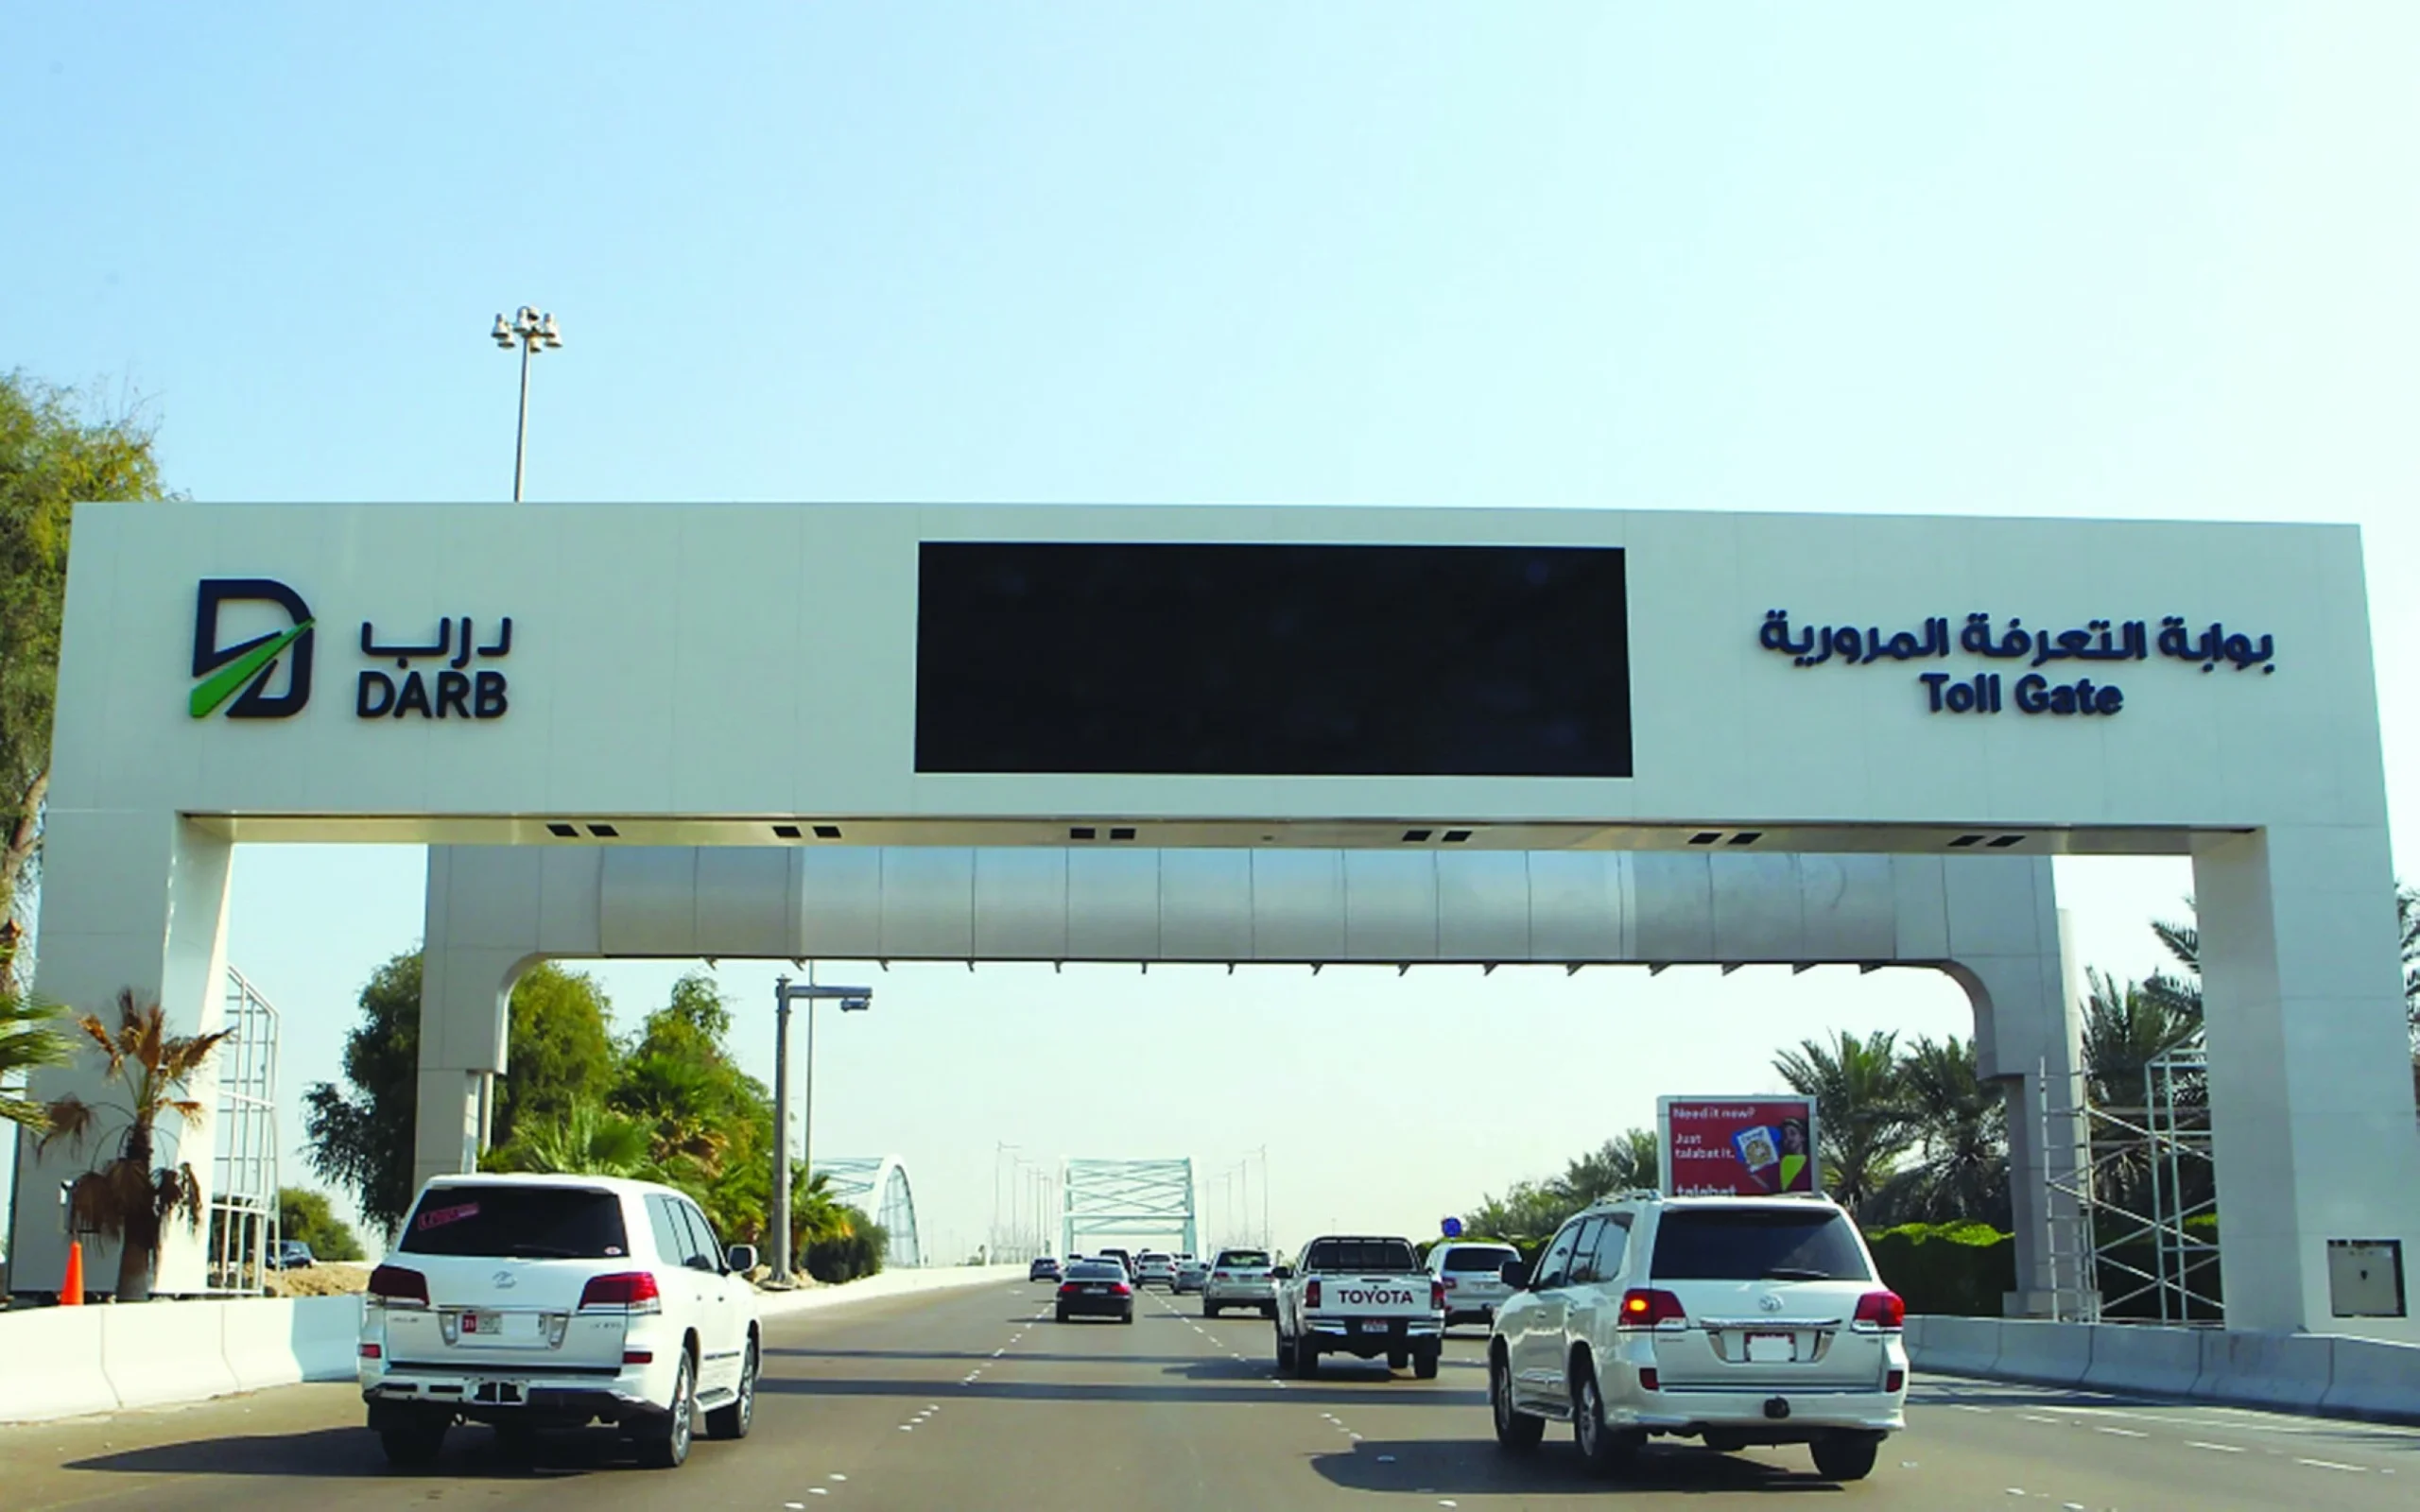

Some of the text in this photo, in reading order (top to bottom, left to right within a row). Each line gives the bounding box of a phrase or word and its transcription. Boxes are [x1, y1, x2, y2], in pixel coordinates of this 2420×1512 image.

[361, 617, 512, 669] درب
[1760, 610, 2274, 674] بوابة التعرفة المرورية
[356, 671, 509, 719] DARB
[1920, 673, 2123, 715] Toll Gate
[1673, 1108, 1708, 1120] Need
[1709, 1108, 1720, 1119] it
[1675, 1133, 1702, 1144] Just
[1339, 1290, 1414, 1304] TOYOTA
